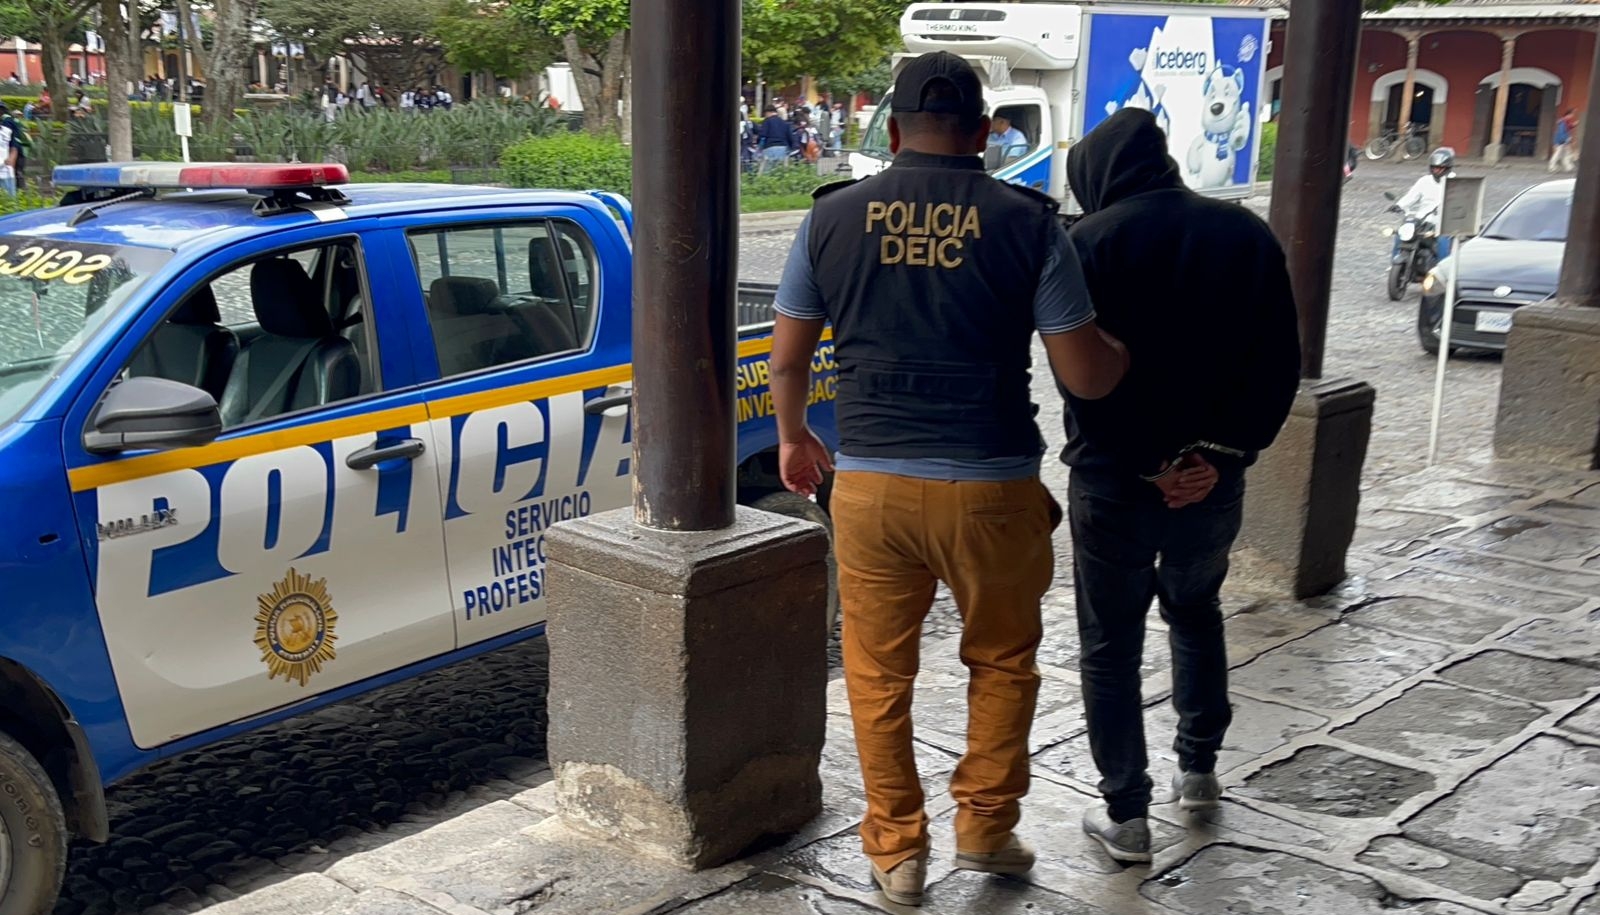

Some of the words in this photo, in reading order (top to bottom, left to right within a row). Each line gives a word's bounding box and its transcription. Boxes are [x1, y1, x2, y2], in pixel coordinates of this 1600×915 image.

[925, 23, 958, 32] THERMO
[959, 24, 978, 32] KING
[1155, 46, 1208, 75] iceberg
[865, 200, 981, 239] POLICIA
[880, 235, 964, 269] DEIC
[505, 490, 591, 540] SERVICIO
